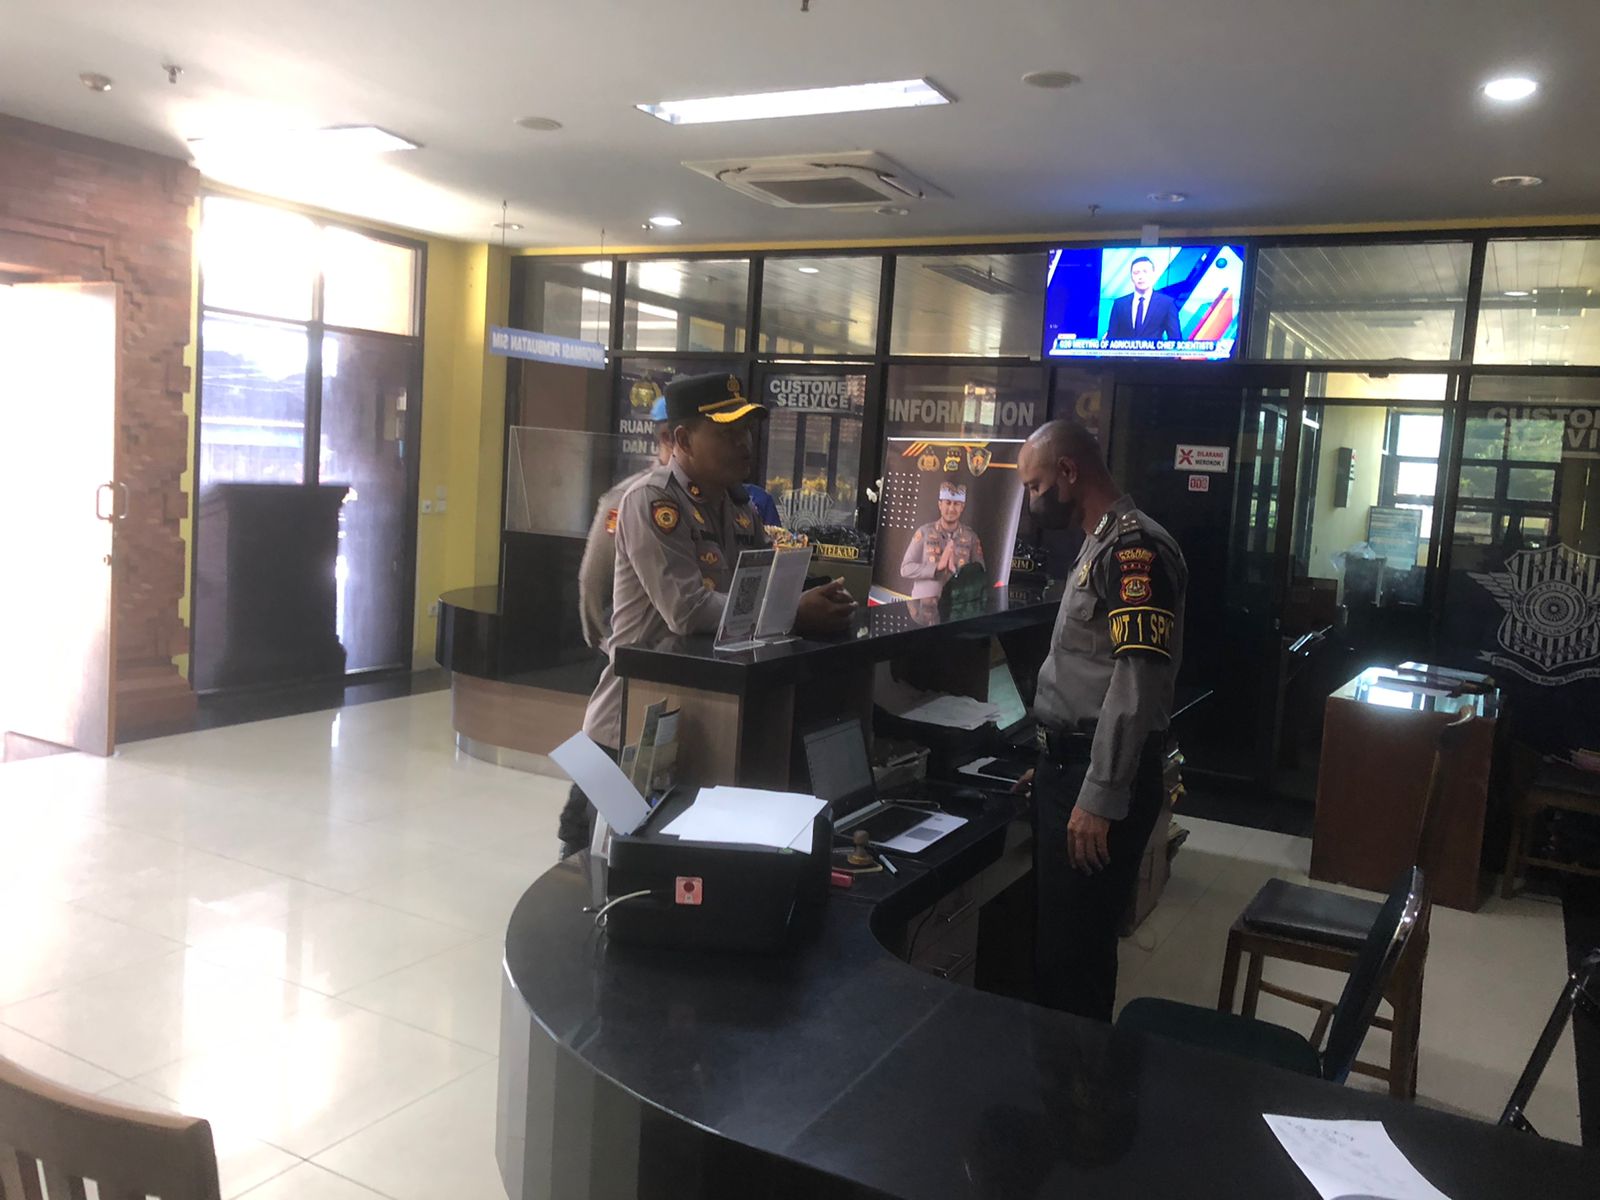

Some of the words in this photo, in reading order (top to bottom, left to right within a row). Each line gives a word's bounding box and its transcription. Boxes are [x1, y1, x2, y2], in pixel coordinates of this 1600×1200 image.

[1072, 340, 1099, 349] MEETING
[1100, 340, 1109, 349] OF
[1110, 340, 1155, 350] AGRICULTURAL
[1157, 341, 1176, 350] CHIEF
[1177, 341, 1214, 350] SCIENTISTS
[769, 379, 857, 395] CUSTOME
[776, 392, 849, 409] SERVICE
[888, 399, 1035, 427] INFORMION
[620, 420, 656, 435] RUAN
[622, 439, 647, 453] DAN
[1197, 450, 1224, 459] DILARANG
[1137, 613, 1143, 643] 1
